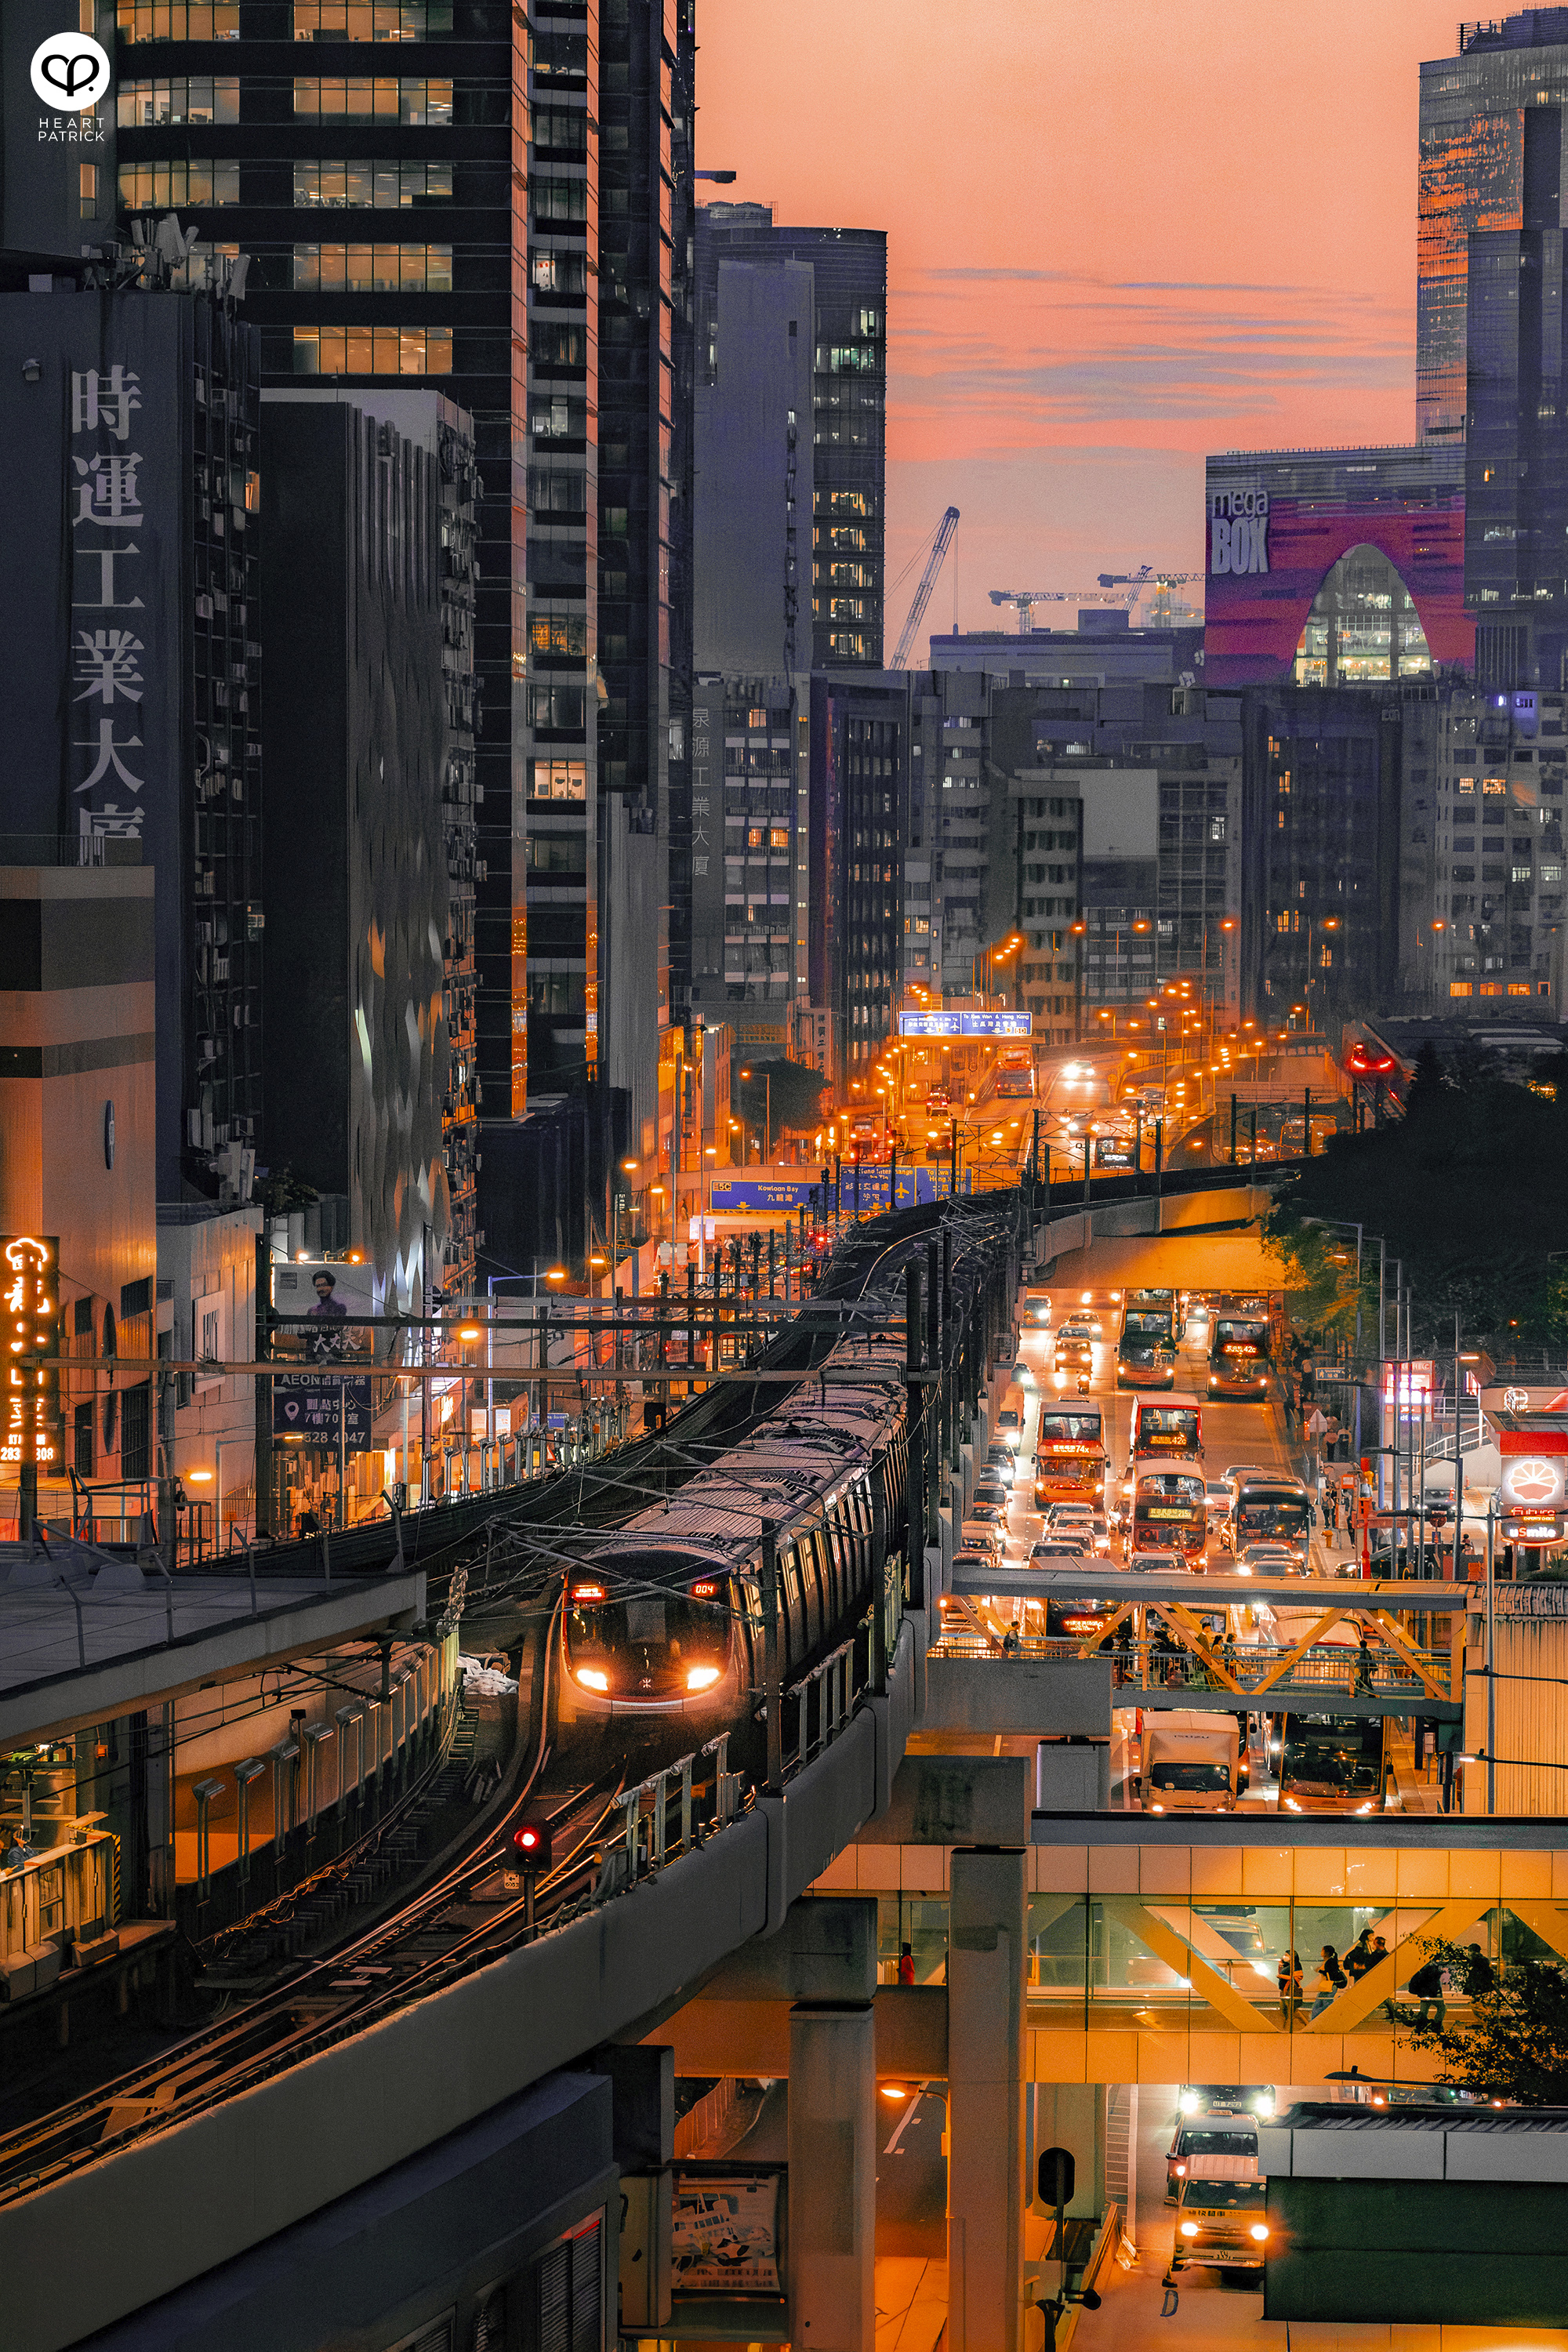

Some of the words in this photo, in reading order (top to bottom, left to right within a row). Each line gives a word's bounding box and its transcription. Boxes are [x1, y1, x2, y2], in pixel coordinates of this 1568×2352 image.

[1212, 490, 1269, 520] mega
[1210, 517, 1269, 575] BOX
[1509, 1526, 1557, 1538] uSmile
[695, 1584, 713, 1594] 004
